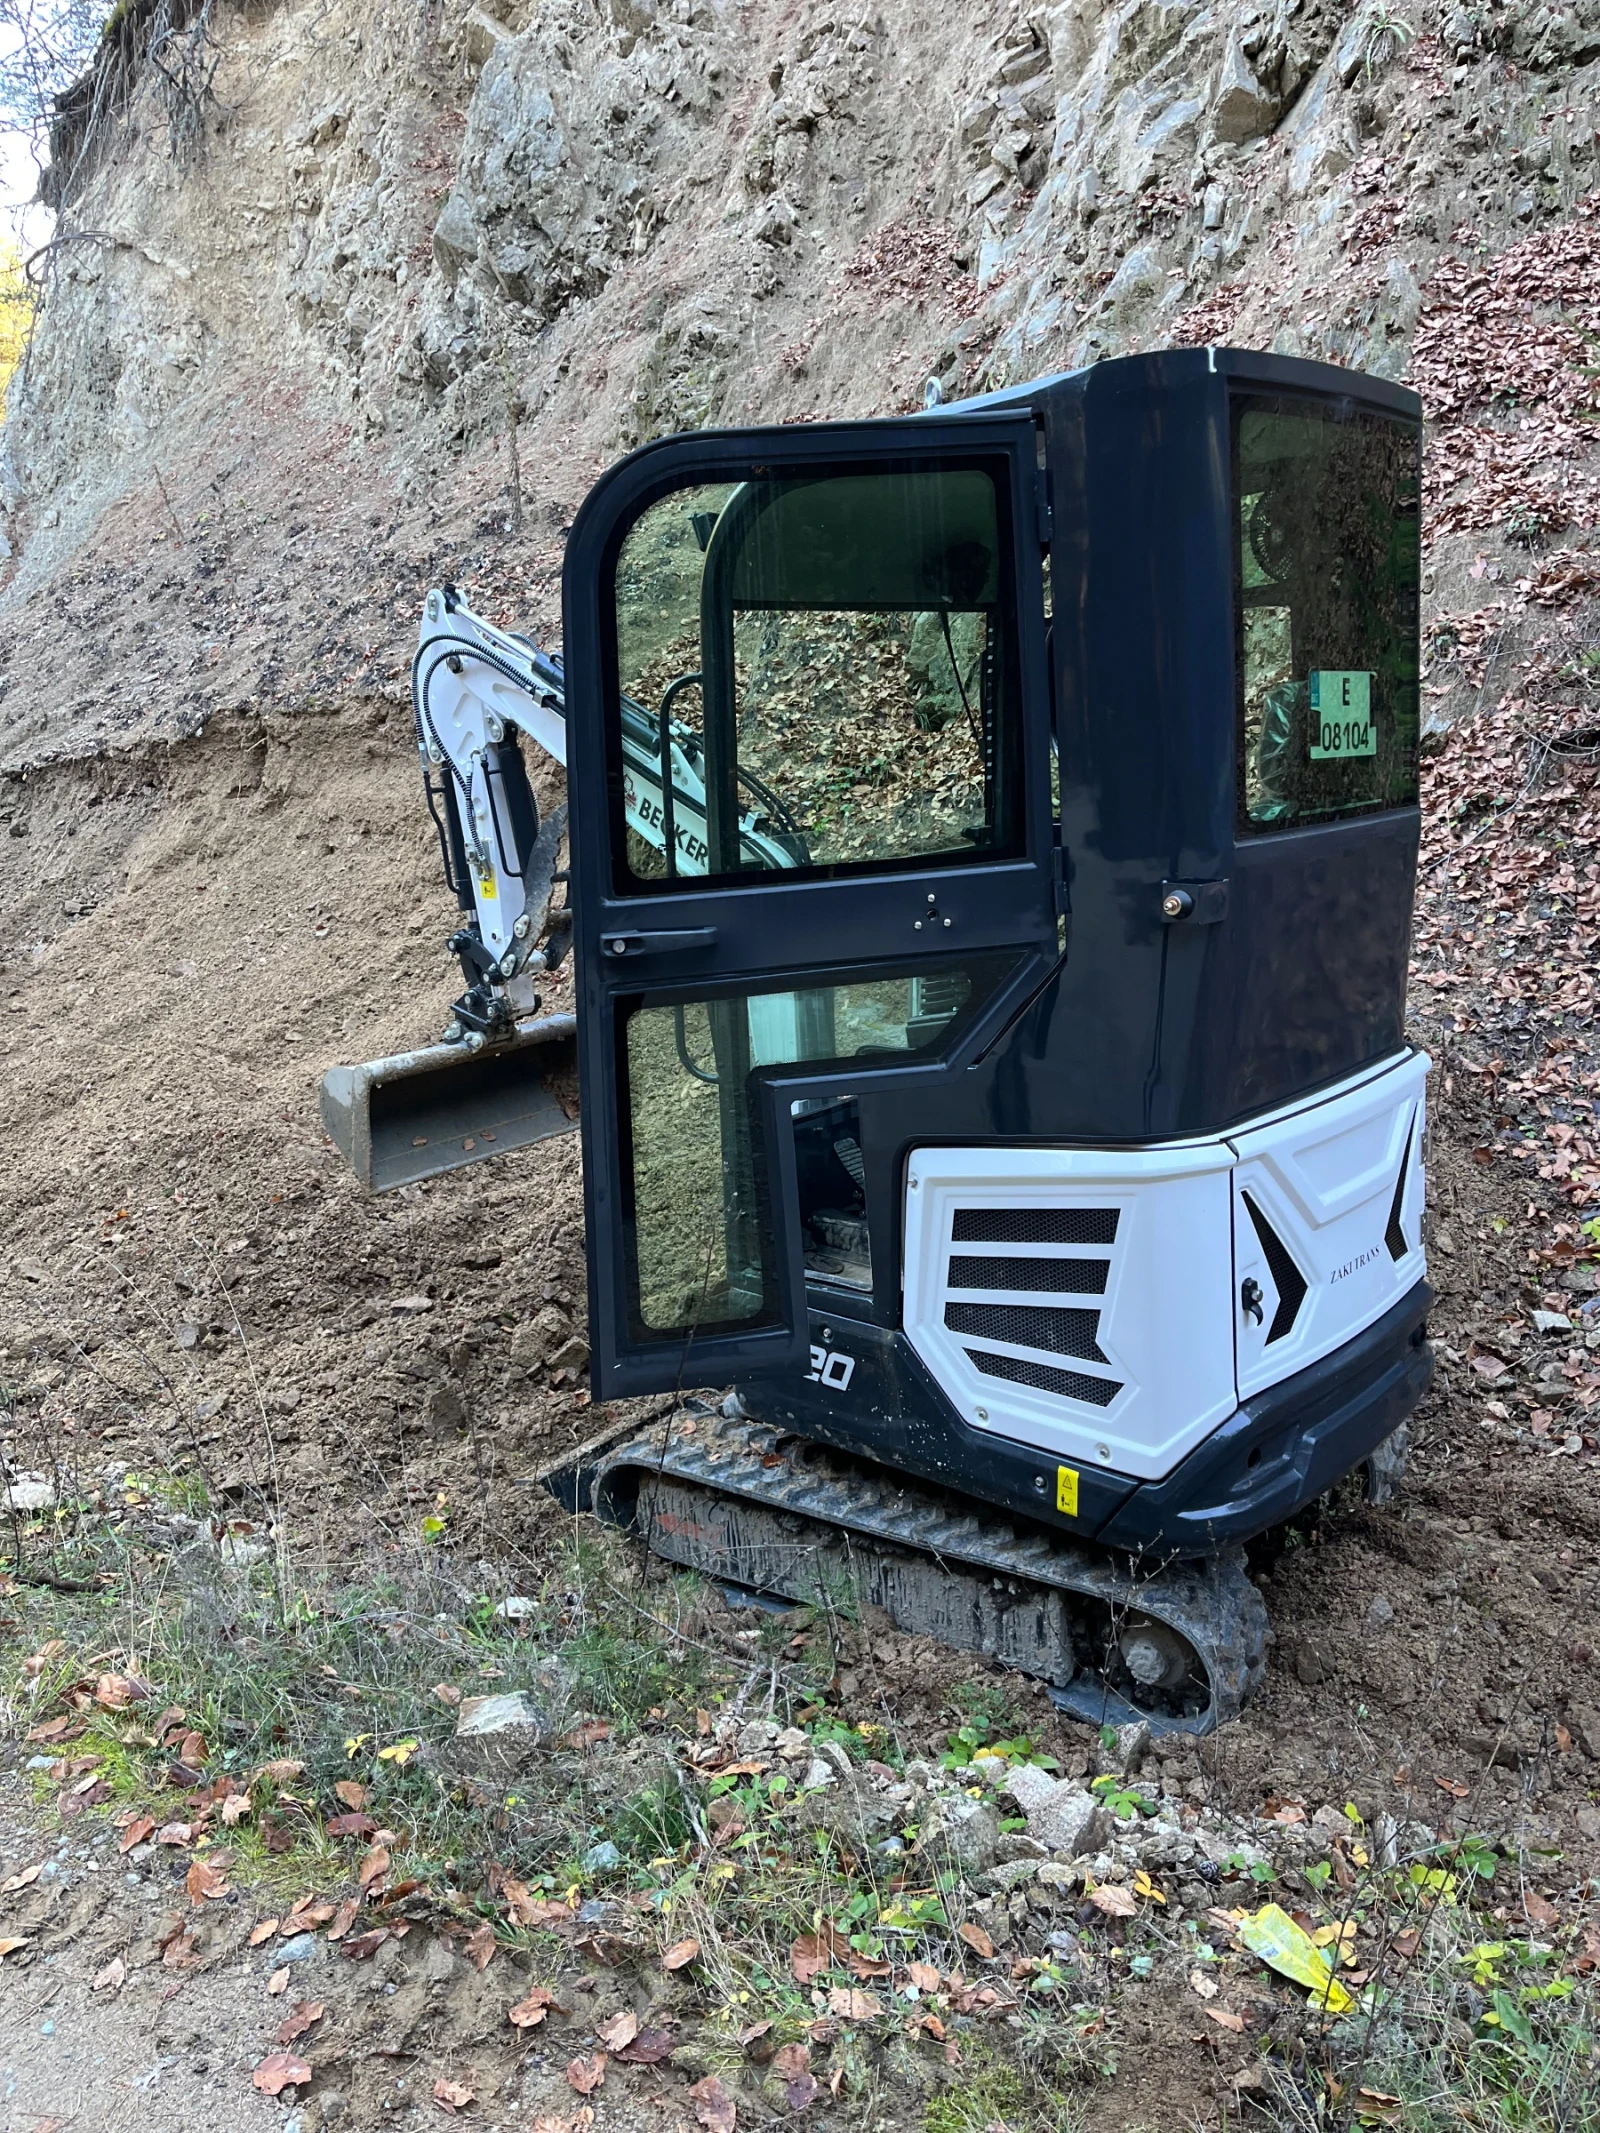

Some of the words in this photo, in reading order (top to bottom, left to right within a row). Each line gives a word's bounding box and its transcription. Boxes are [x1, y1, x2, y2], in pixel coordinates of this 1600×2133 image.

[1342, 677, 1350, 706] E
[1322, 721, 1369, 751] 08104
[1330, 1261, 1353, 1285] ZAKI
[1355, 1244, 1380, 1270] TRANS
